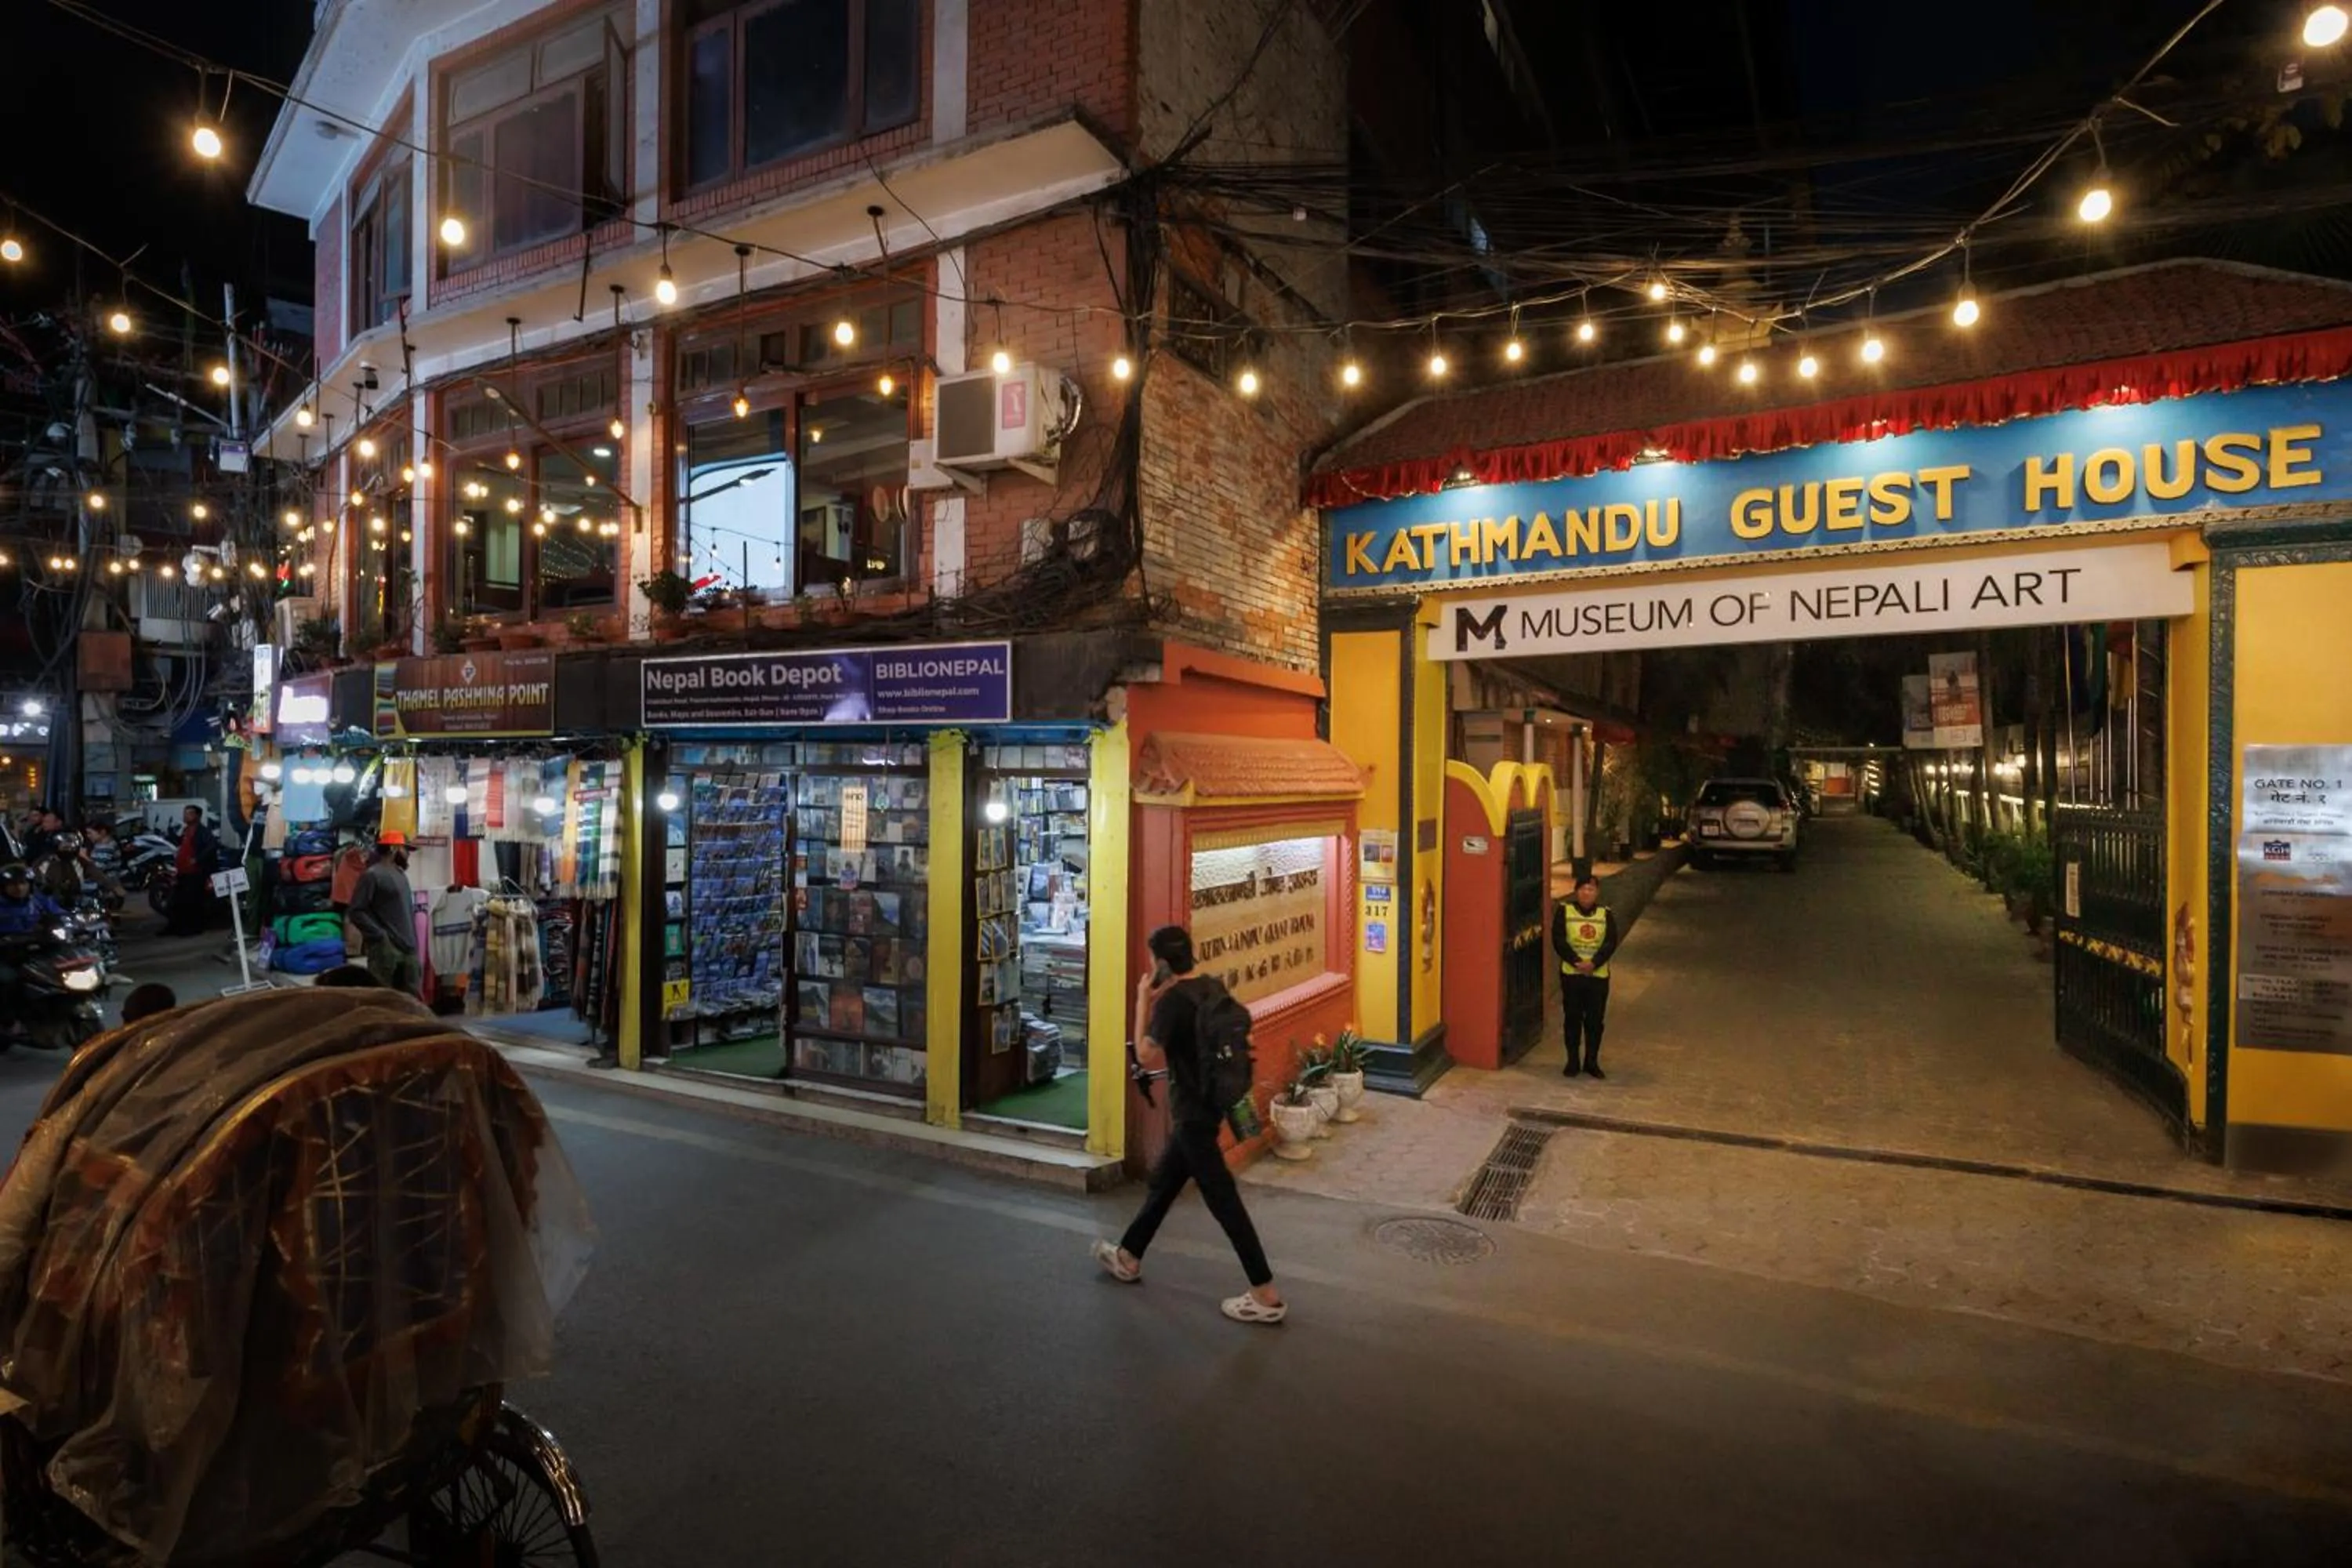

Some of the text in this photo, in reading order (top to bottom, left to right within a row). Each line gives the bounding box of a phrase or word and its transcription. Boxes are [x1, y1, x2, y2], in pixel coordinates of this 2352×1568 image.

[1345, 424, 2321, 575] KATHMANDU GUEST HOUSE
[1521, 597, 1693, 639] MUSEUM
[1709, 591, 1771, 626] OF
[1790, 578, 1949, 622] NEPALI
[1970, 568, 2082, 610] ART
[647, 662, 843, 694] Nepal Book Depot
[876, 659, 1004, 680] BIBLIONEPAL
[397, 683, 549, 711] THAMEL PASHMINA POINT
[2254, 779, 2343, 789] GATE NO. 1
